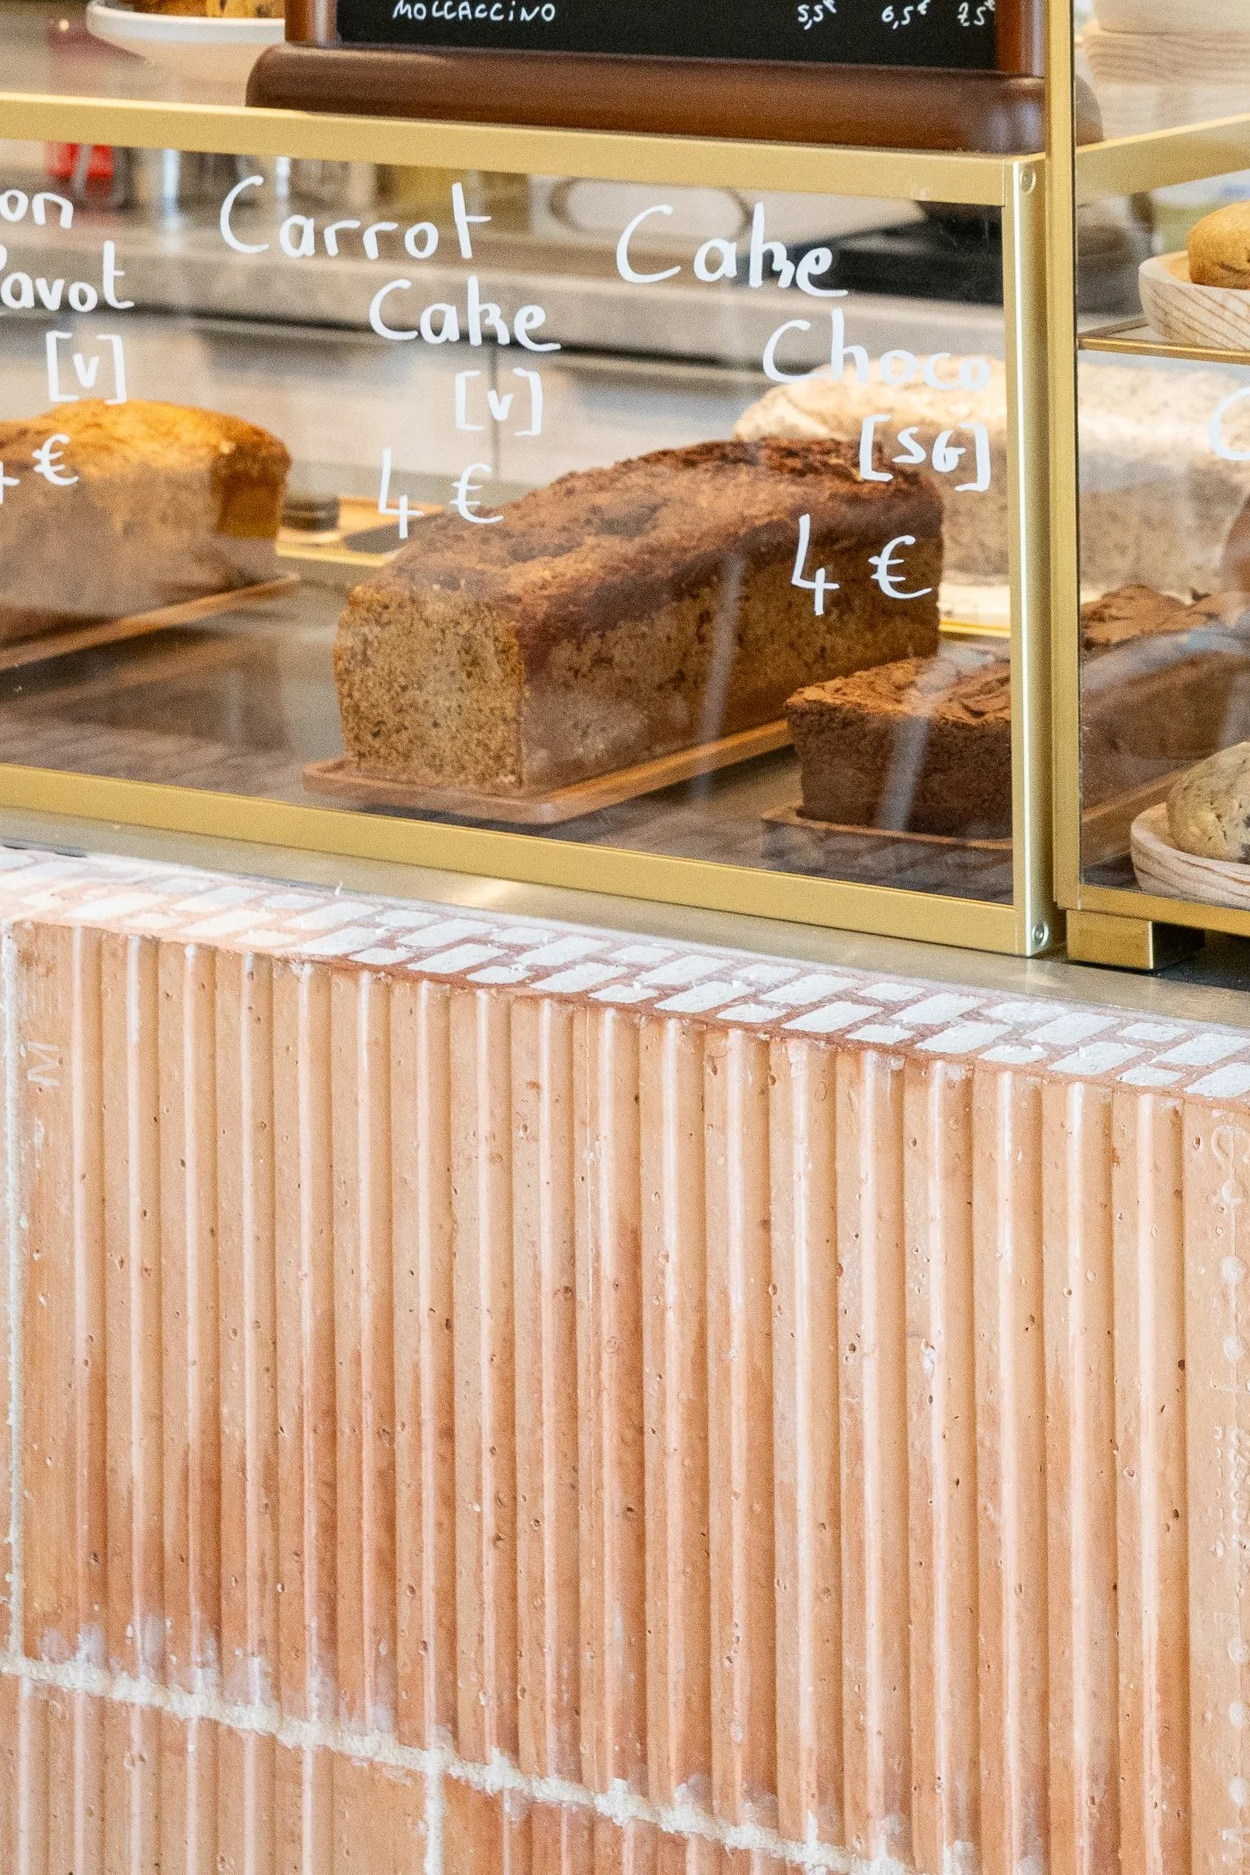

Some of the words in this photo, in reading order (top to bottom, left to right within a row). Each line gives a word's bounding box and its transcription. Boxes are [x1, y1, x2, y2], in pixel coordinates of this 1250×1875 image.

[218, 174, 492, 261] Carrot
[615, 202, 848, 299] Cake
[369, 275, 561, 353] Cake
[762, 307, 991, 391] Choco
